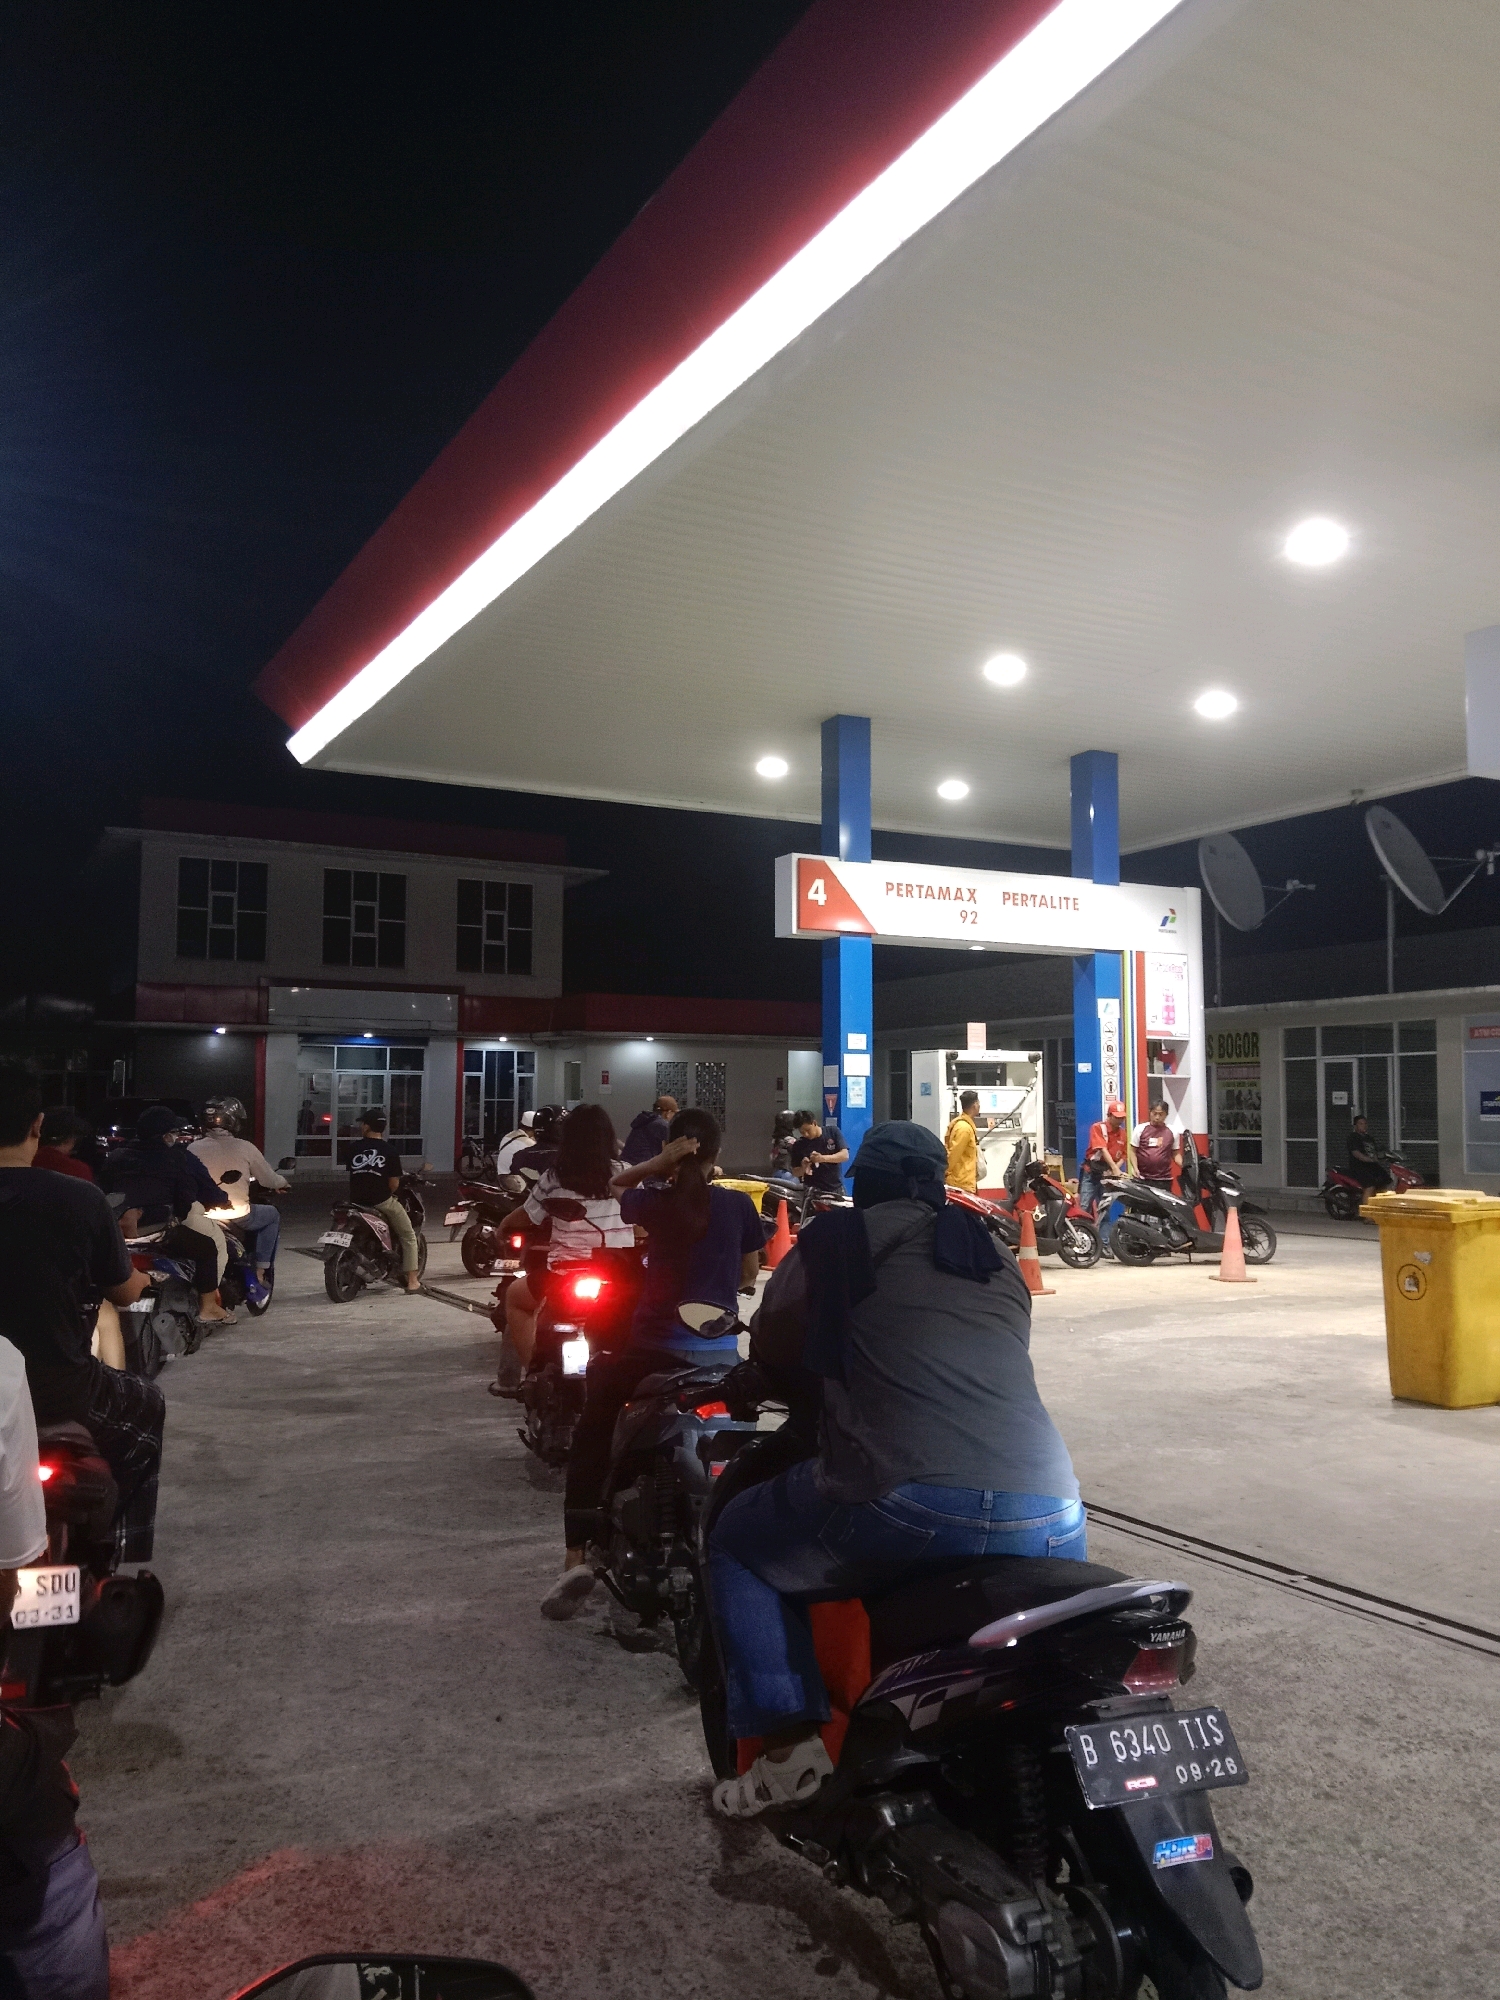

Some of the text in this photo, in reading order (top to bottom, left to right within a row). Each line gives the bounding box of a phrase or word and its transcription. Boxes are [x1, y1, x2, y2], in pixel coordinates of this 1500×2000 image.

[807, 878, 828, 906] 4
[885, 881, 1080, 911] PERTAMAX PERTALITE
[960, 909, 978, 924] 92
[1218, 1032, 1259, 1059] BOGOR
[36, 1572, 76, 1596] SDU
[1150, 1629, 1186, 1642] YAMAHA
[1080, 1715, 1225, 1766] B 6340 TIS
